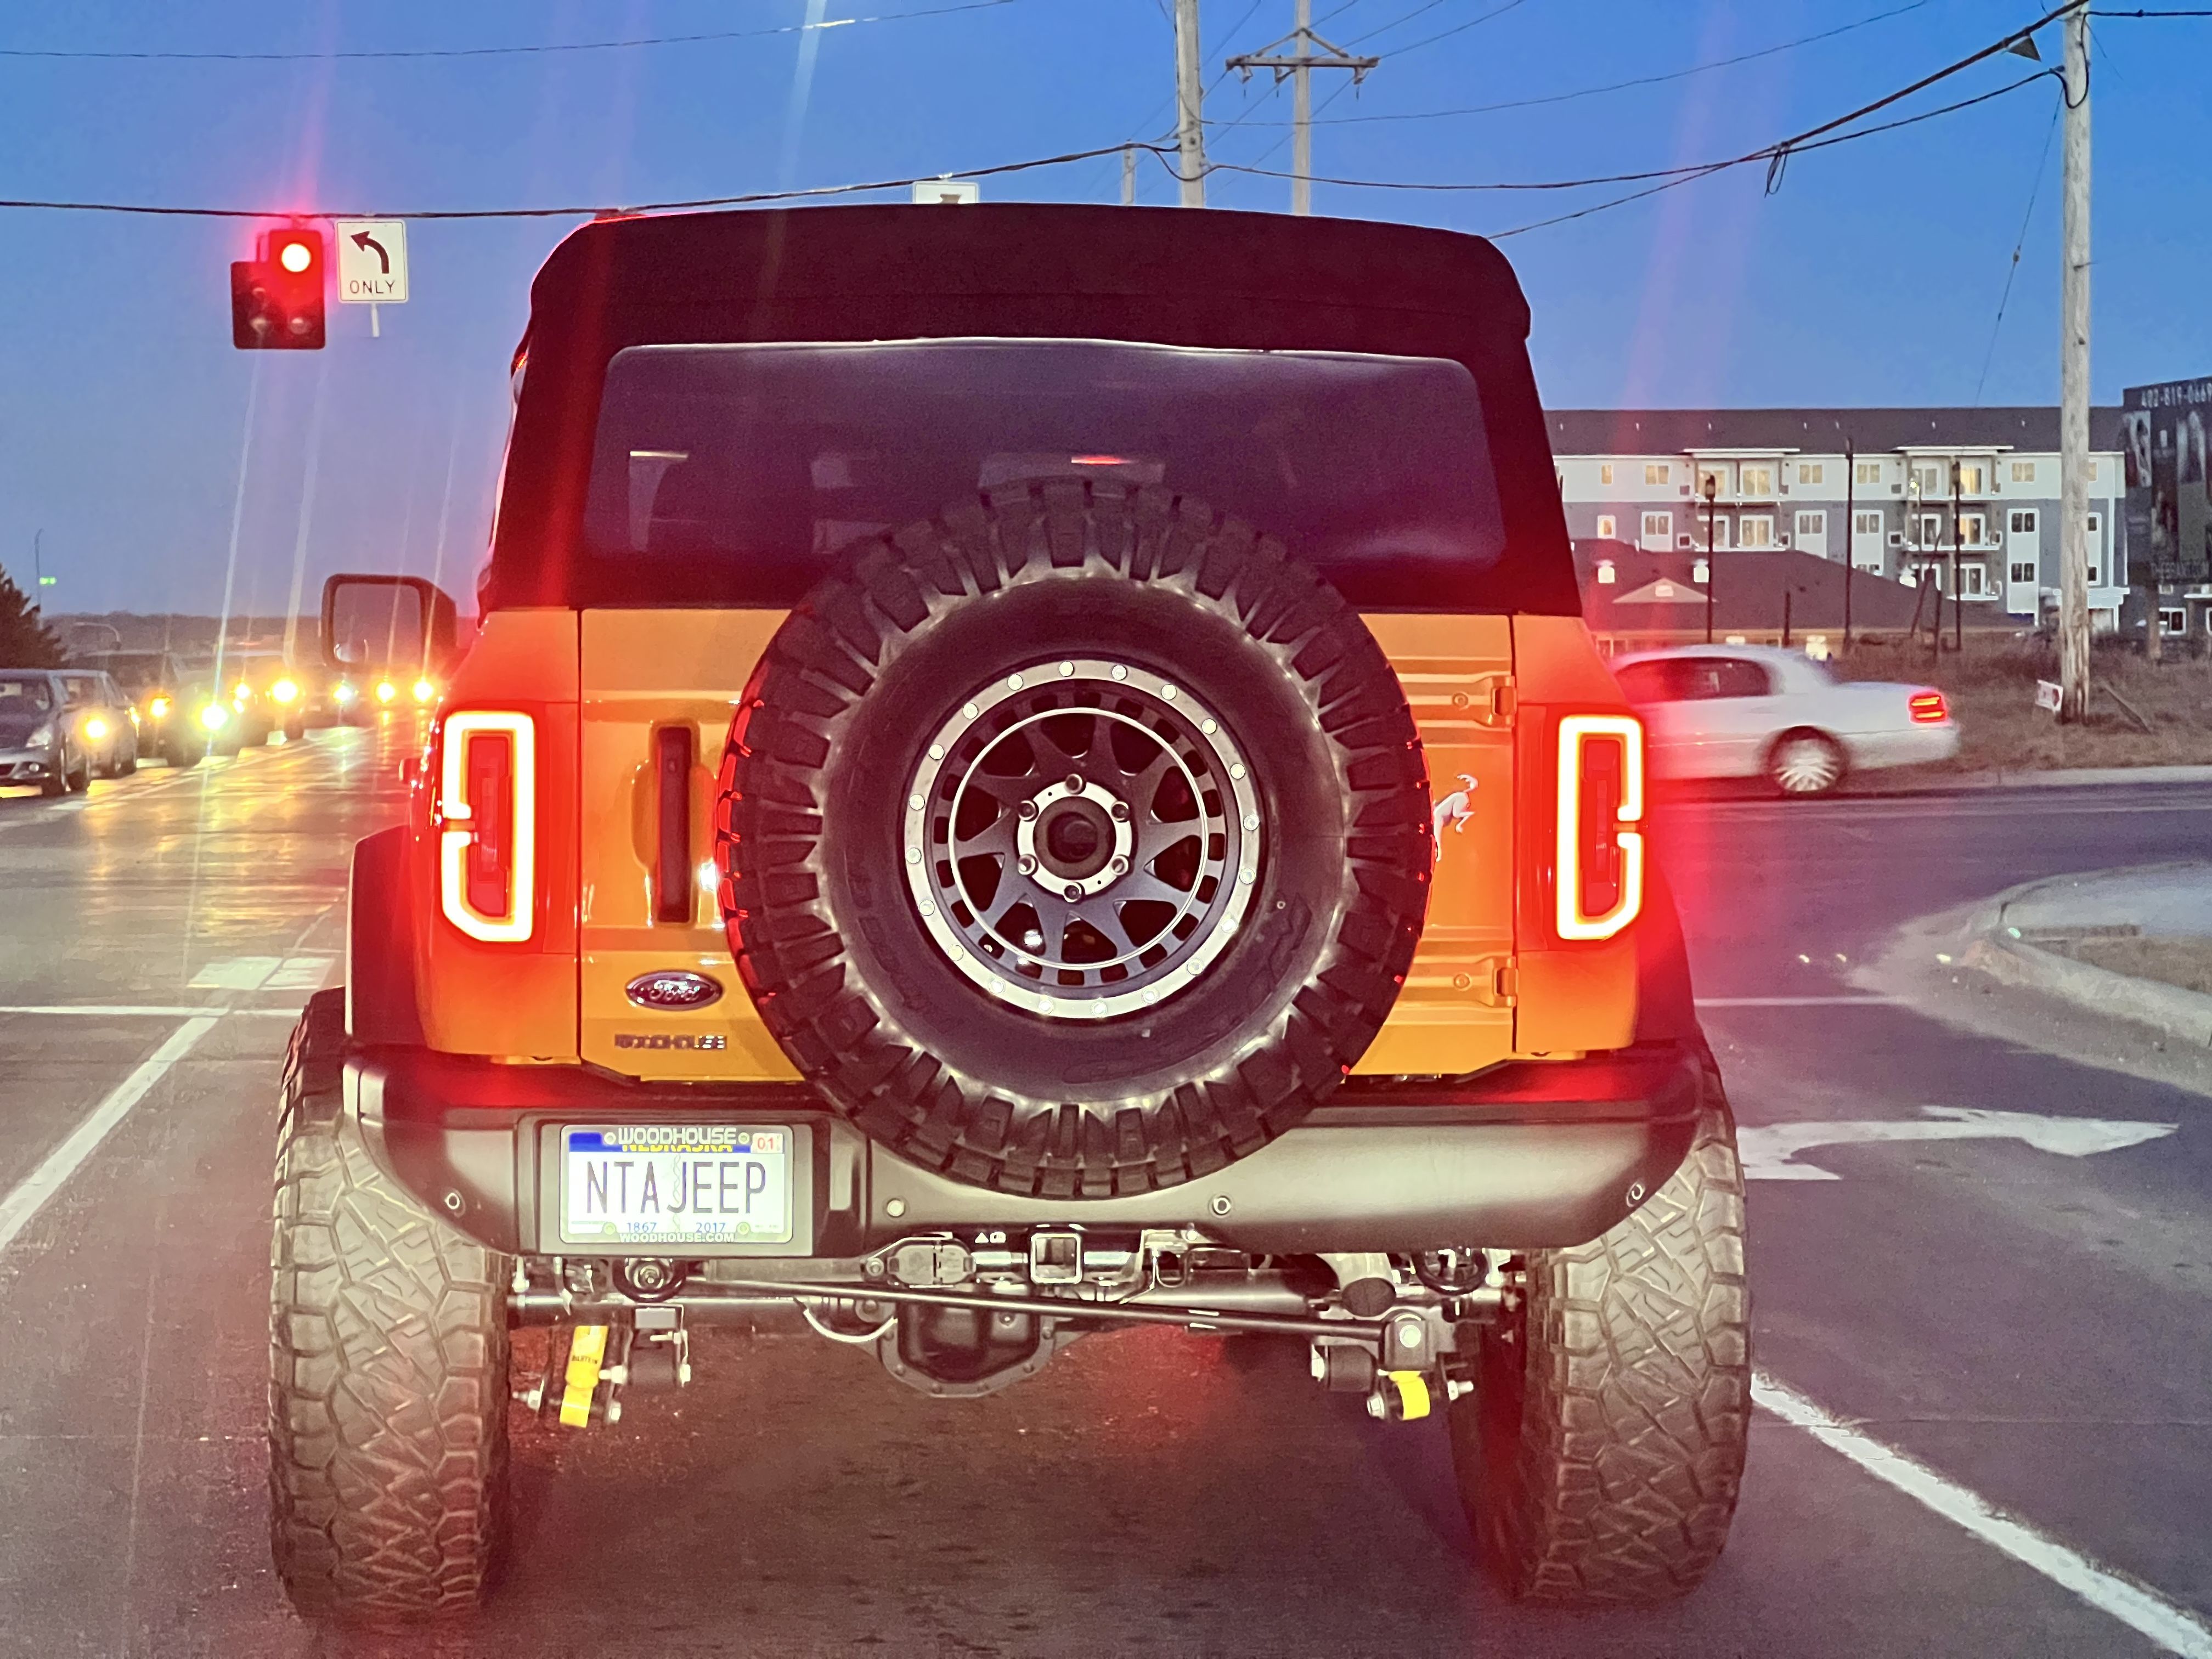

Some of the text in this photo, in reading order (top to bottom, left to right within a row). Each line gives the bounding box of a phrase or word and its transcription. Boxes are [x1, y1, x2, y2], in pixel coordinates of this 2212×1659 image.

[349, 280, 395, 294] ONLY
[618, 1127, 736, 1145] WOODHOUSE
[757, 1137, 774, 1150] 01
[586, 1161, 766, 1214] NTAJEEP
[627, 1222, 657, 1233] 1867
[696, 1222, 726, 1233] 2017
[619, 1233, 735, 1243] WOODHOUSE.COM
